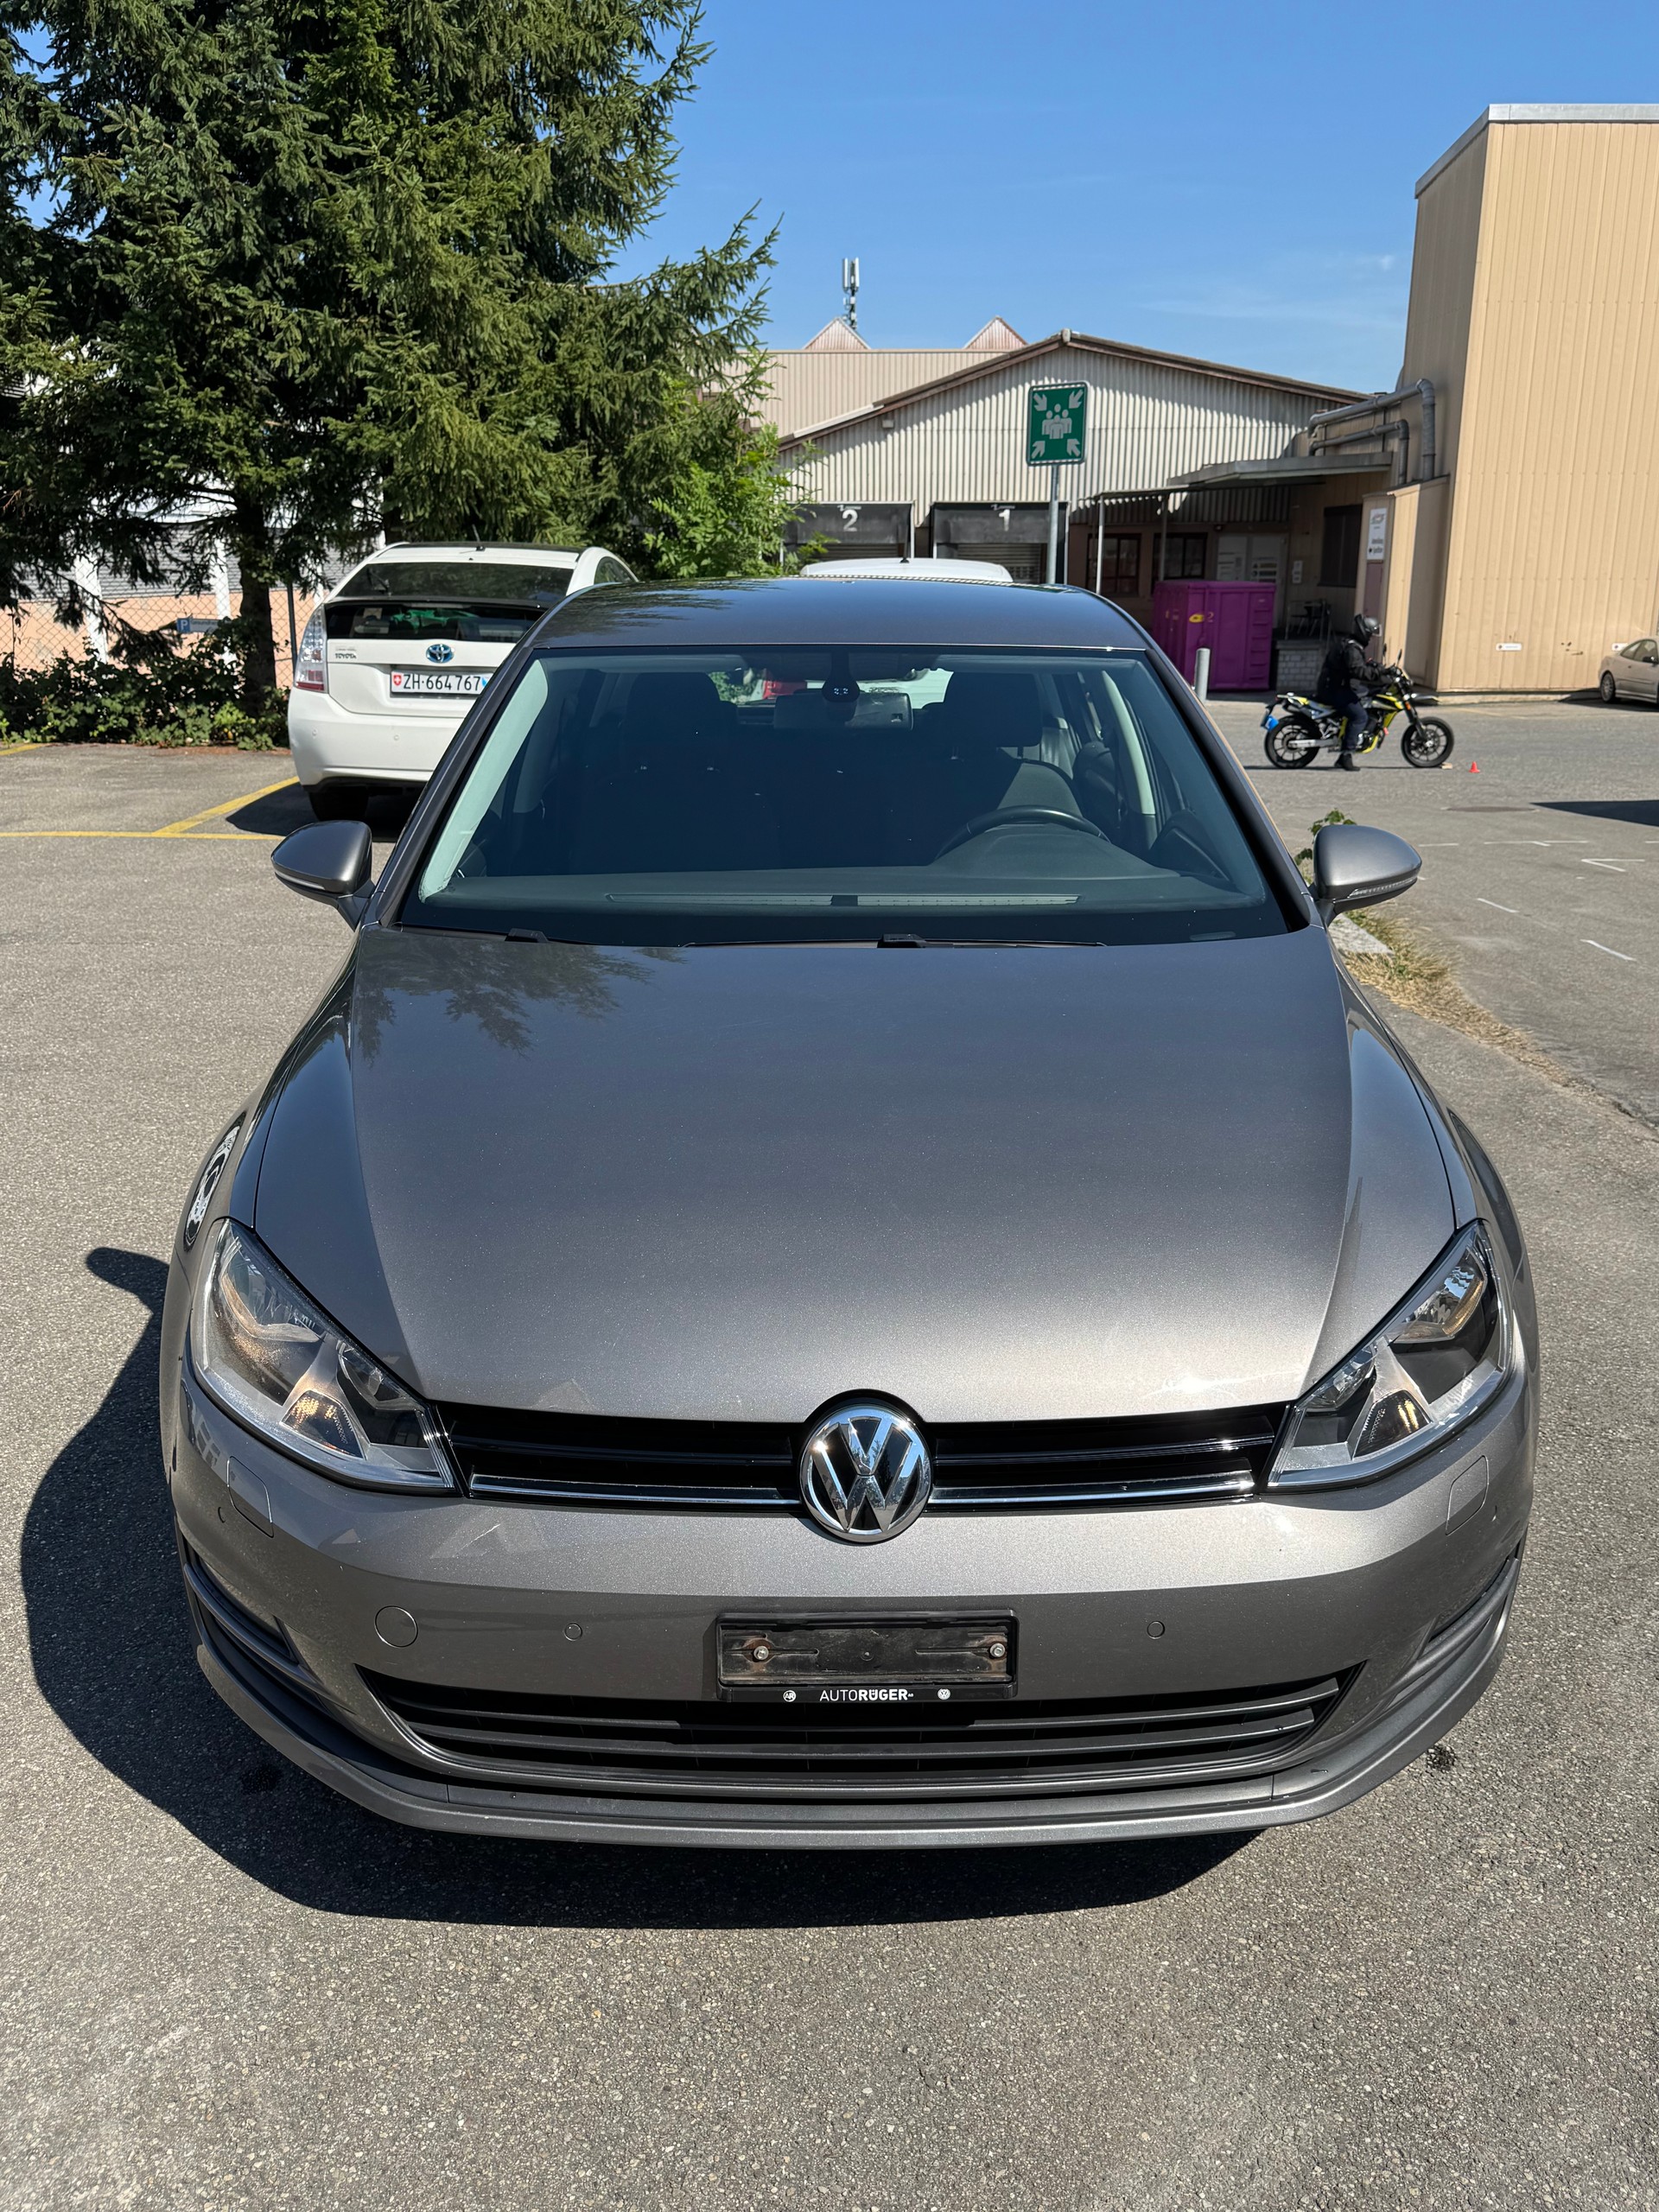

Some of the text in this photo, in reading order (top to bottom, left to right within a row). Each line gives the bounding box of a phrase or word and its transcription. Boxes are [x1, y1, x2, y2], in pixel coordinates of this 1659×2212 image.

[842, 510, 858, 531] 2
[999, 509, 1010, 531] 1
[180, 619, 188, 631] P
